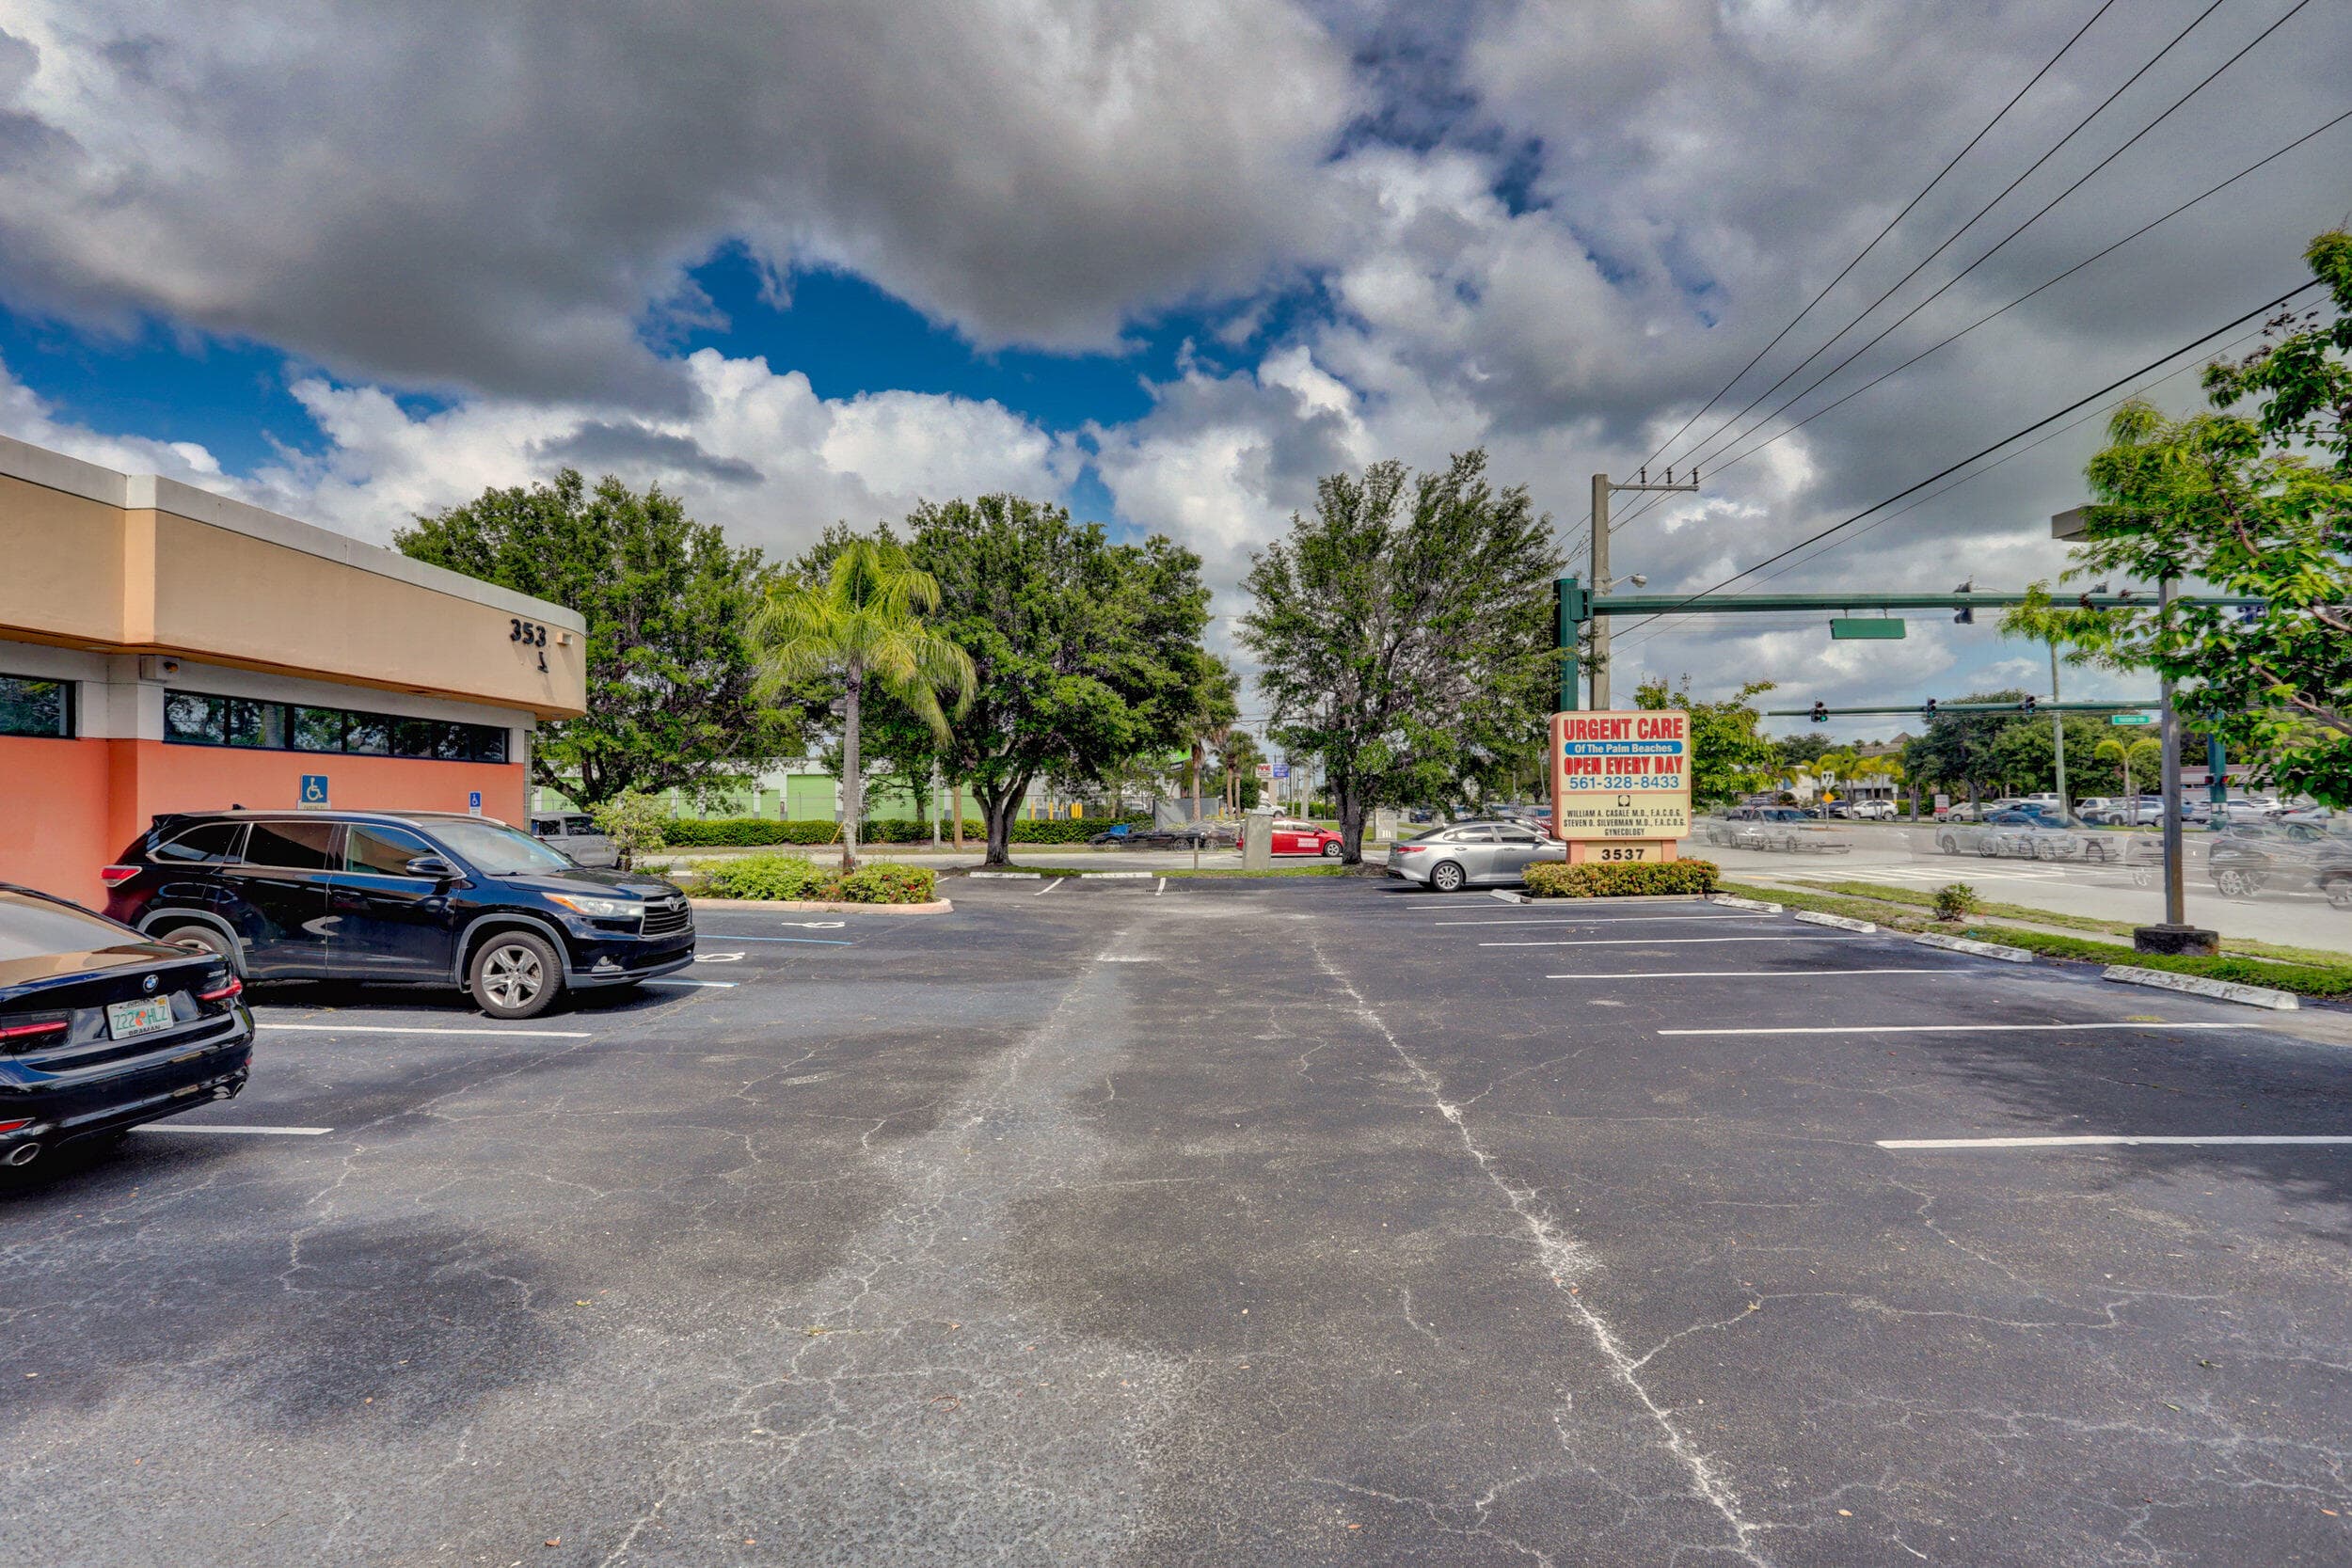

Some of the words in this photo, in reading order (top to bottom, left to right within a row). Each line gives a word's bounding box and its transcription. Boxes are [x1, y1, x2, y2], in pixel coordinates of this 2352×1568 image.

[1564, 718, 1632, 740] URGENT
[1637, 718, 1684, 740] CARE
[1574, 744, 1586, 753] Of
[1586, 744, 1604, 753] The
[1606, 744, 1629, 753] Palm
[1631, 743, 1673, 752] Beaches
[1564, 756, 1601, 775] OPEN
[1606, 756, 1650, 775] EVERY
[1654, 755, 1684, 774] DAY
[1569, 776, 1679, 789] 561-328-8433
[1566, 809, 1596, 817] WILLIAM
[1606, 809, 1629, 817] CASALE
[1564, 818, 1587, 827] STEVEN
[1597, 818, 1633, 827] SILVERMAN
[1604, 828, 1645, 836] GYNECOLOGY
[1601, 848, 1645, 861] 3537
